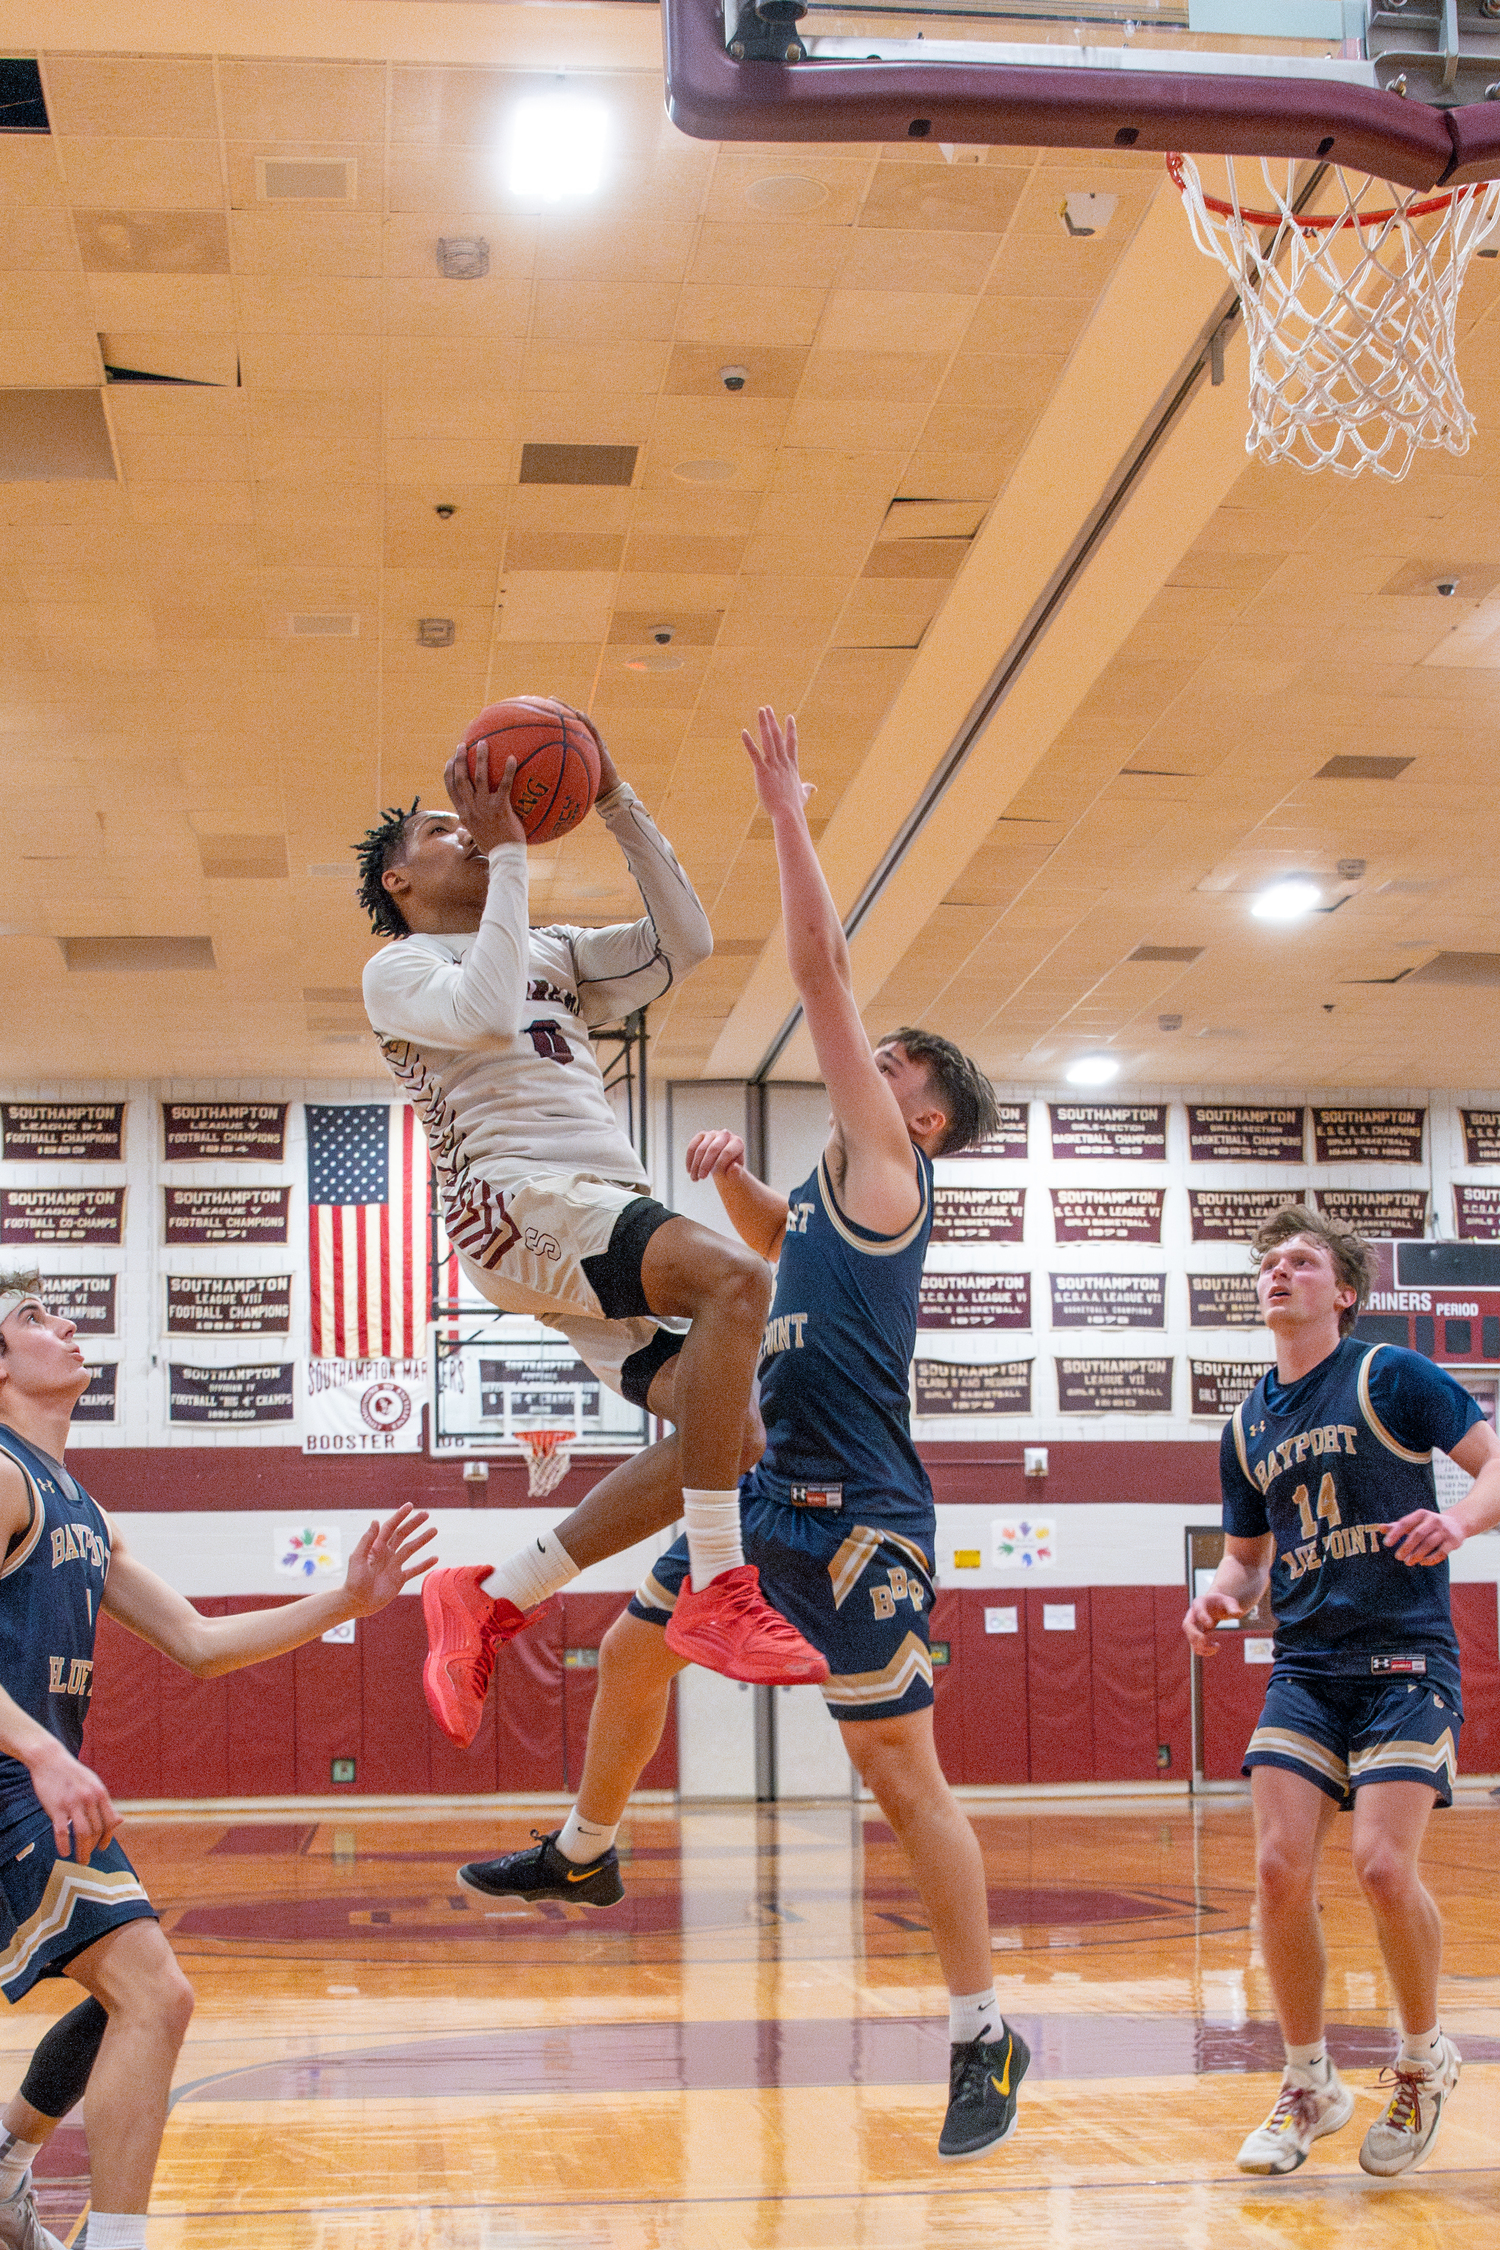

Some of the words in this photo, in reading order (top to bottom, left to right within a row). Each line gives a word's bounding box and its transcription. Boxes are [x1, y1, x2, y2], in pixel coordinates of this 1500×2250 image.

[9, 1107, 116, 1120] SOUTHAMPTON
[171, 1107, 279, 1120] SOUTHAMPTON
[1057, 1108, 1158, 1121] SOUTHAMPTON
[1195, 1109, 1297, 1124] SOUTHAMPTON
[1320, 1110, 1416, 1125] SOUTHAMPTON
[20, 1122, 77, 1131] LEAGUE
[190, 1121, 244, 1130] LEAGUE
[247, 1121, 260, 1131] V
[5, 1132, 58, 1143] FOOTBALL
[61, 1133, 118, 1144] CHAMPIONS
[168, 1132, 220, 1143] FOOTBALL
[223, 1132, 281, 1144] CHAMPIONS
[1052, 1133, 1112, 1145] BASKETBALL
[1114, 1134, 1165, 1145] CHAMPIONS
[1191, 1134, 1249, 1146] BASKETBALL
[8, 1192, 116, 1206] SOUTHAMPTON
[174, 1190, 281, 1205] SOUTHAMPTON
[934, 1190, 1021, 1205] UTHAMPTON
[1057, 1190, 1158, 1205] SOUTHAMPTON
[1197, 1193, 1298, 1206] SOUTHAMPTON
[1323, 1192, 1421, 1207] SOUTHAMPTON
[25, 1207, 80, 1216] LEAGUE
[84, 1206, 97, 1215] V
[192, 1206, 247, 1216] LEAGUE
[250, 1206, 262, 1215] V
[970, 1206, 1009, 1218] LEAGUE
[1010, 1206, 1024, 1218] VI
[1108, 1206, 1147, 1218] LEAGUE
[1148, 1206, 1161, 1218] VI
[1374, 1207, 1411, 1220] LEAGUE
[1412, 1208, 1425, 1221] VI
[4, 1218, 56, 1229] FOOTBALL
[59, 1218, 118, 1229] CO-CHAMPS
[168, 1217, 222, 1228] FOOTBALL
[226, 1217, 285, 1228] CHAMPIONS
[1091, 1218, 1151, 1228] BASKETBALL
[42, 1279, 111, 1293] HAMPTON
[170, 1278, 289, 1293] SOUTHAMPTON
[920, 1275, 1025, 1290] SOUTHAMPTON
[1055, 1276, 1160, 1291] SOUTHAMPTON
[195, 1293, 237, 1305] LEAGUE
[971, 1291, 1012, 1304] LEAGUE
[1016, 1291, 1028, 1304] VI
[1102, 1291, 1144, 1304] LEAGUE
[1213, 1291, 1256, 1303] LEAGUE
[1366, 1291, 1432, 1312] RINERS
[169, 1305, 223, 1319] FOOTBALL
[229, 1304, 289, 1319] CHAMPIONS
[955, 1305, 1024, 1315] BASKETBALL
[1435, 1303, 1479, 1317] PERIOD
[917, 1361, 1029, 1378] SOUTHAMPTON
[1062, 1360, 1168, 1374] SOUTHAMPTON
[182, 1367, 281, 1381] SOUTHAMPTON
[307, 1360, 396, 1397] SOUTHAMPTON
[1083, 1374, 1124, 1386] LEAGUE
[1216, 1377, 1256, 1390] LEAGUE
[171, 1393, 218, 1407] FOOTBALL
[256, 1393, 293, 1407] CHAMPS
[306, 1433, 396, 1451] BOOSTER
[1253, 1424, 1358, 1496] BAYPORT
[1292, 1471, 1343, 1541] 14
